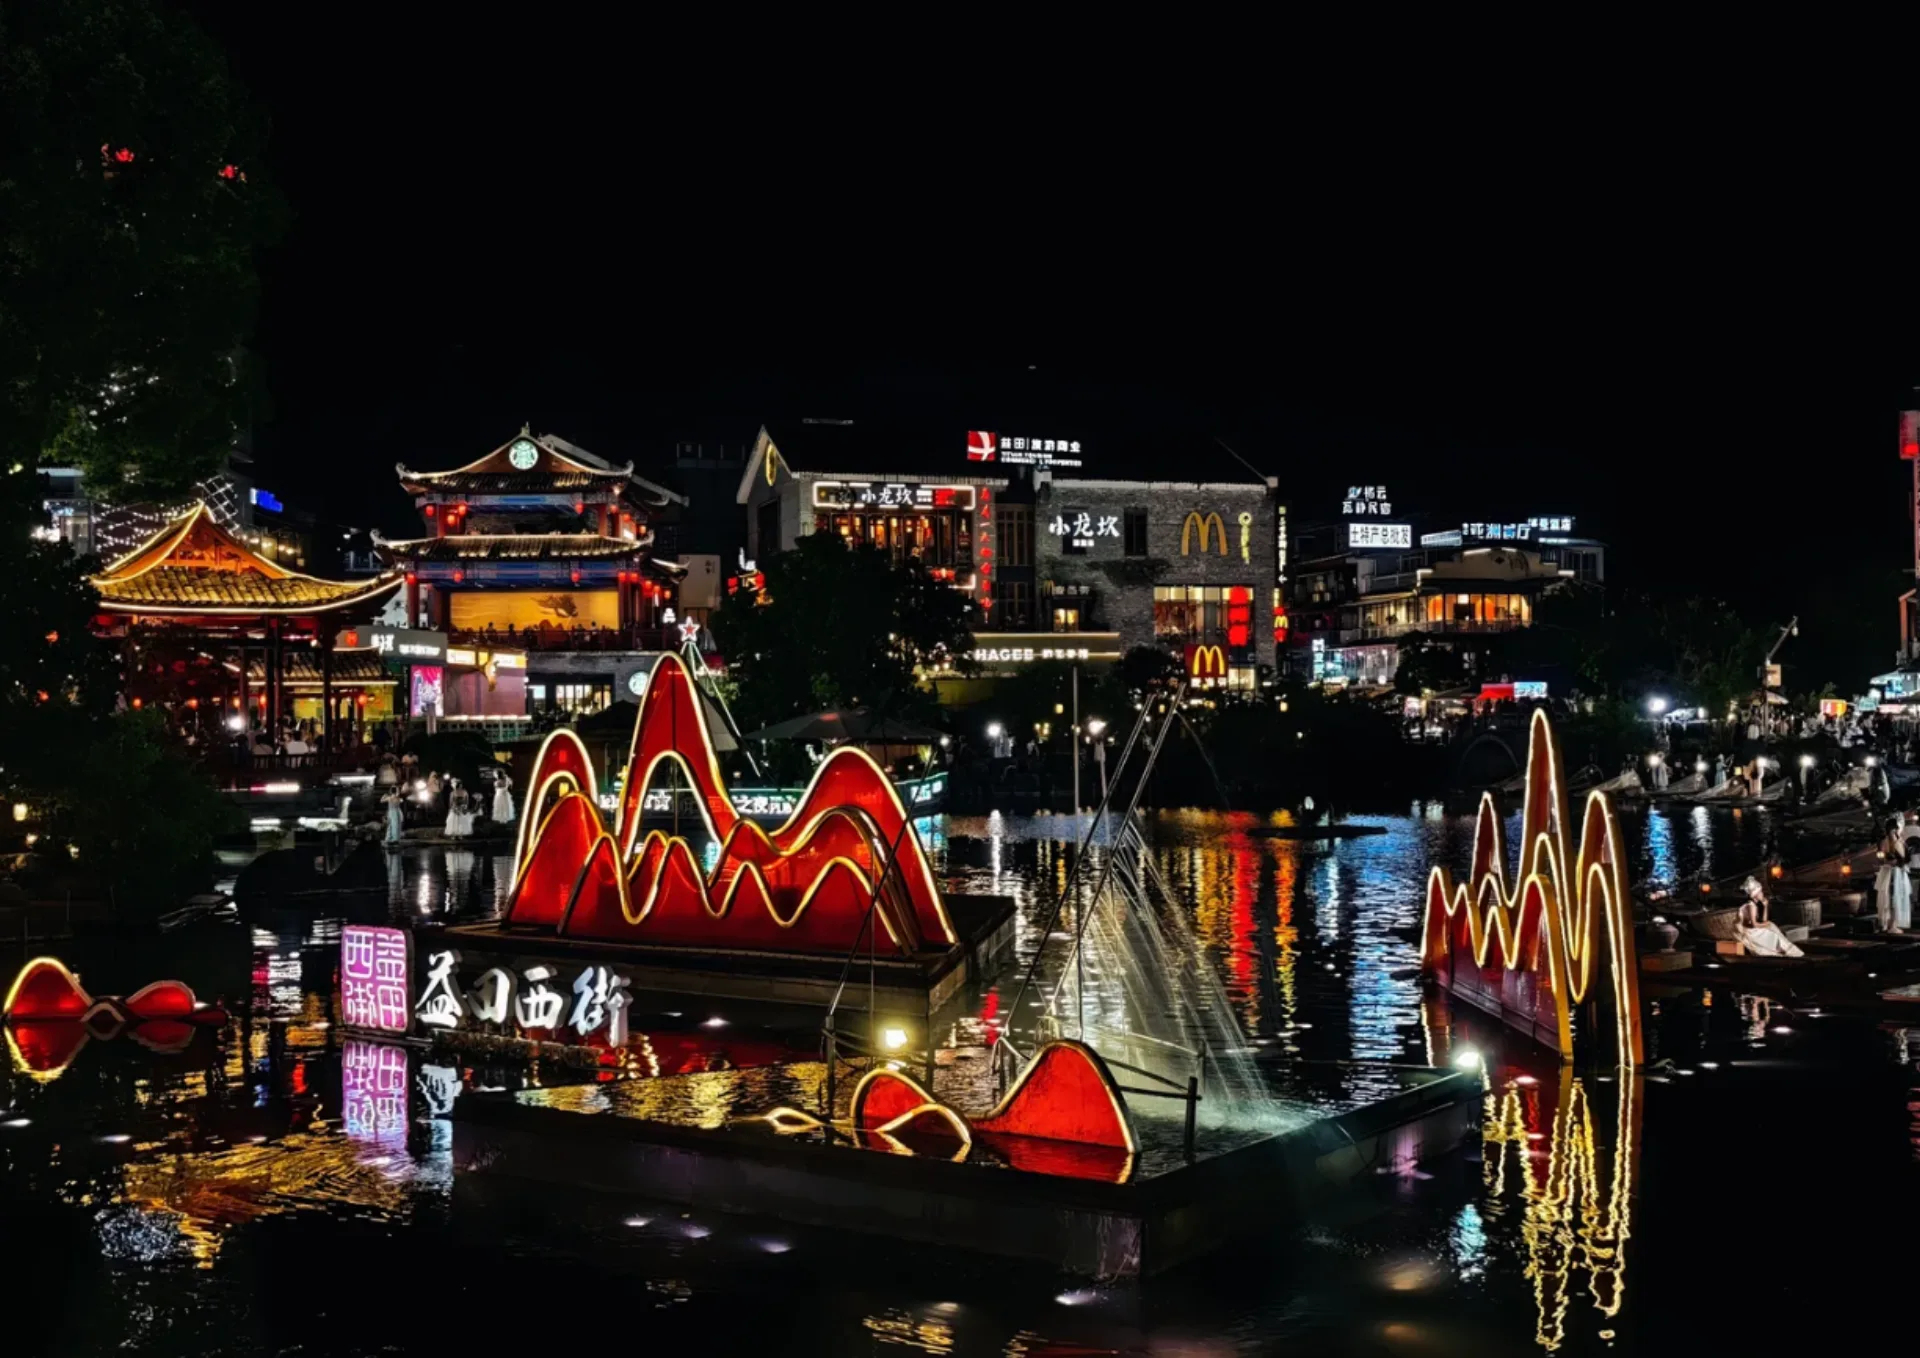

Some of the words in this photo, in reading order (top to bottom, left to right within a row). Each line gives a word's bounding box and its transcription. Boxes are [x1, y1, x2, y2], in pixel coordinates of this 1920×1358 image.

[861, 487, 913, 505] 小龙坎
[1048, 512, 1120, 537] 小龙坎
[974, 648, 1034, 661] HAGEE
